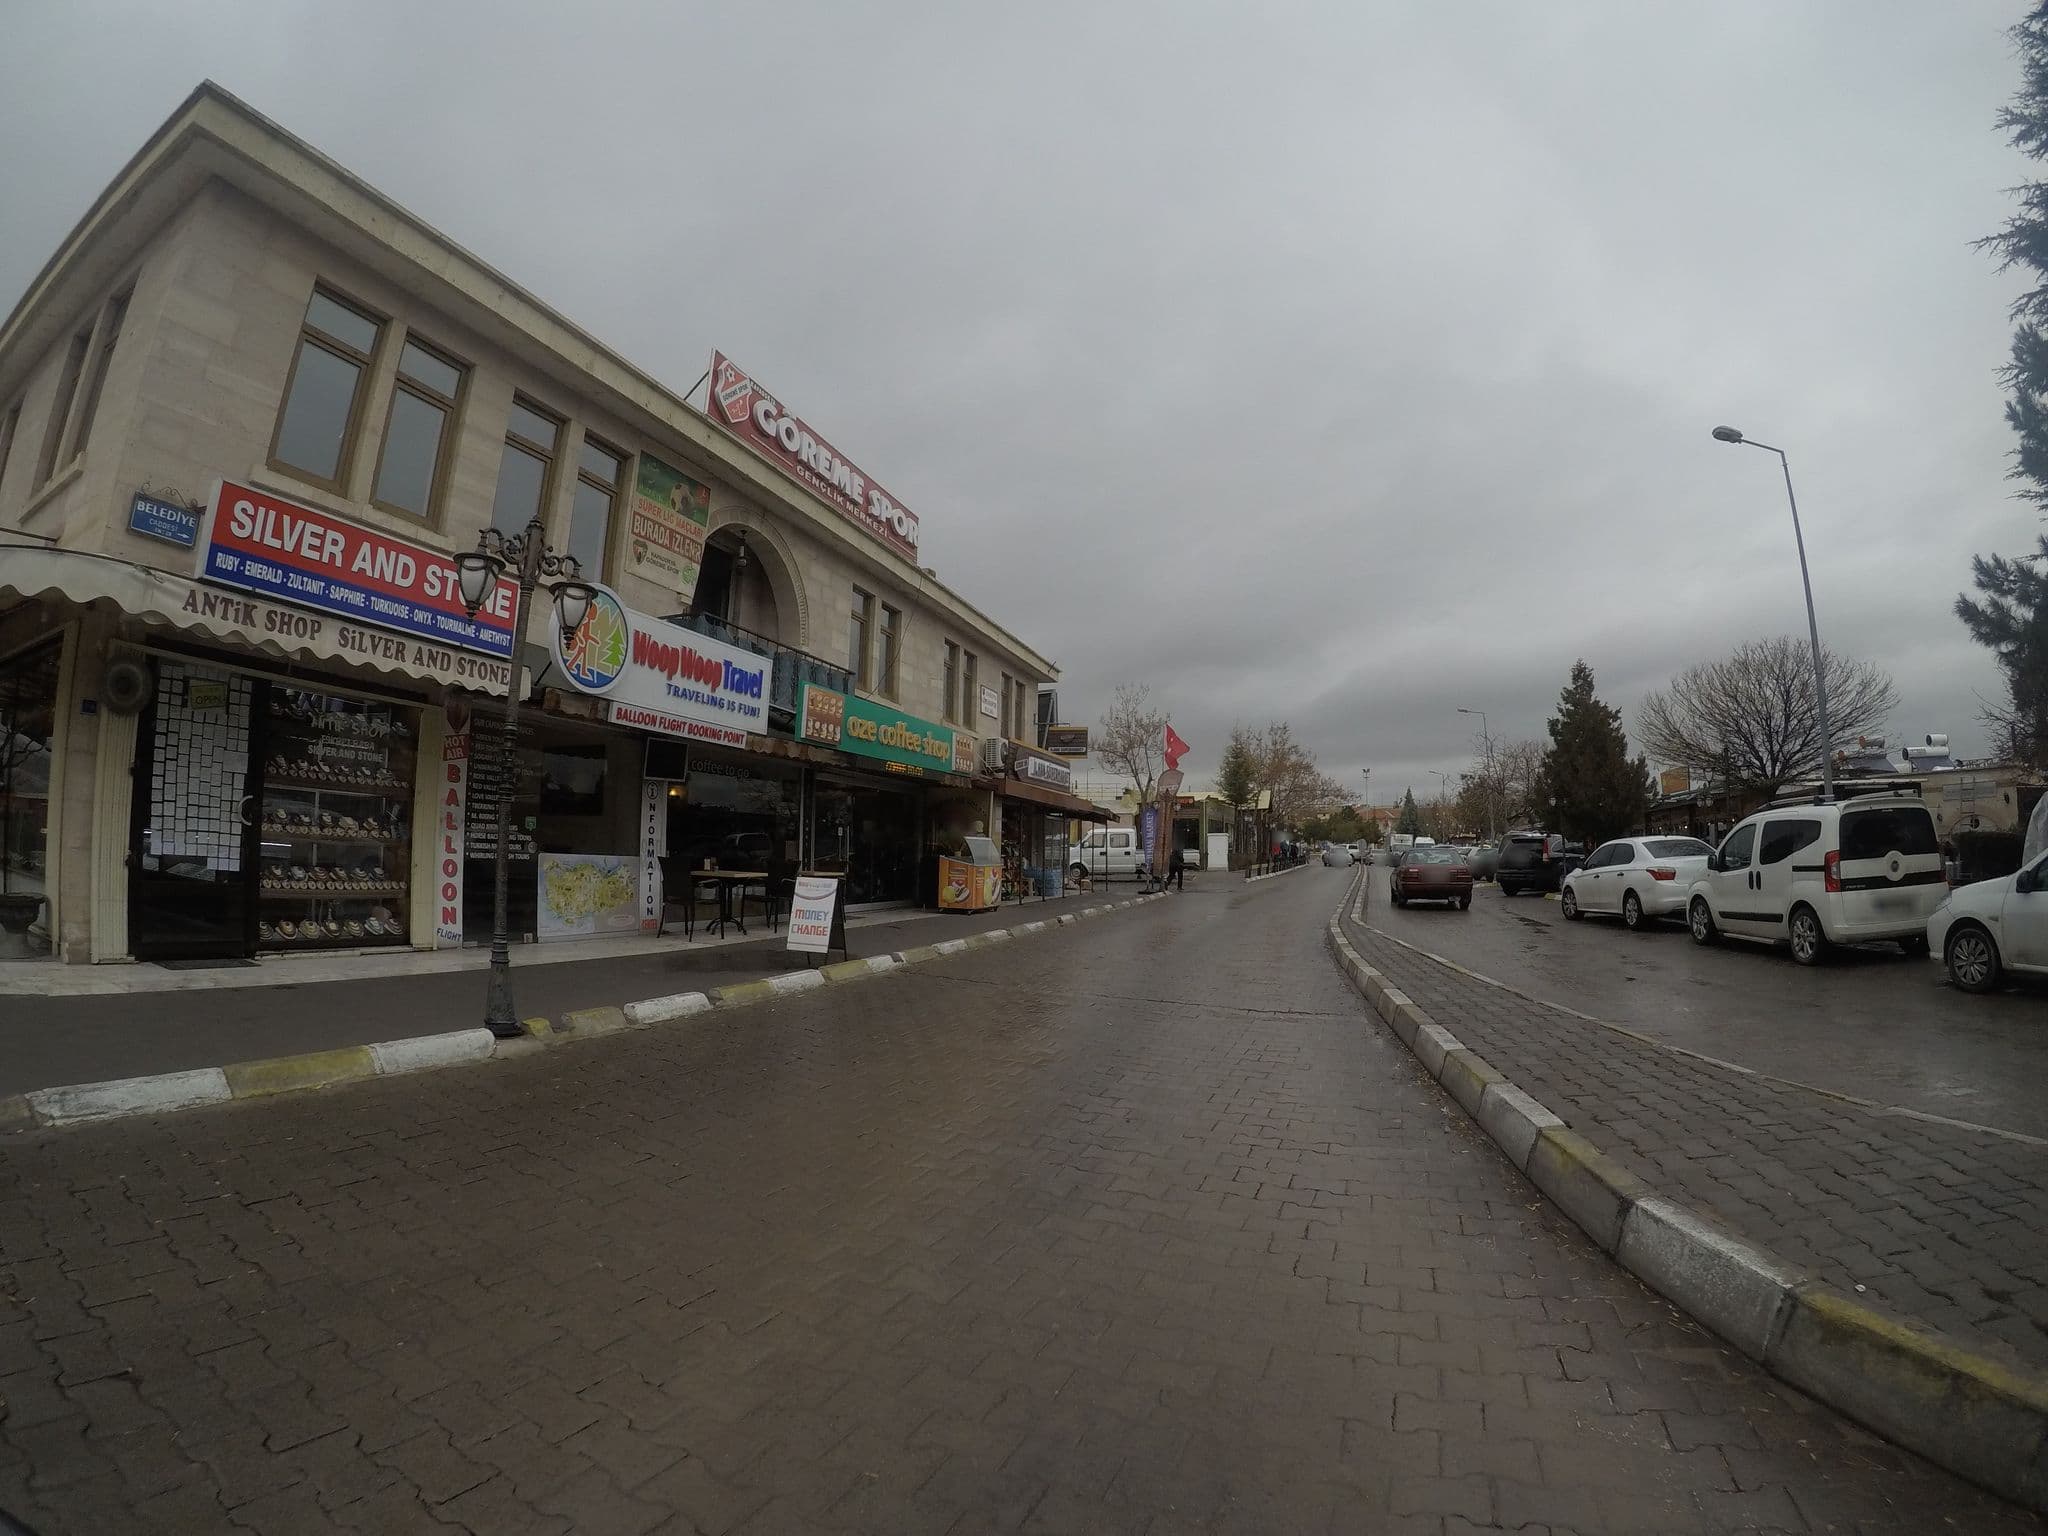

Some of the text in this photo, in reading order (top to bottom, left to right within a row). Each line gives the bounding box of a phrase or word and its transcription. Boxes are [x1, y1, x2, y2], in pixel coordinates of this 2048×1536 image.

[633, 515, 670, 549] BURADA
[868, 489, 919, 548] SPOR
[230, 500, 346, 568] SILVER
[351, 541, 417, 588] AND
[215, 552, 241, 572] RUBY
[244, 560, 282, 584] EMERALD
[287, 573, 326, 596] ZULTANIT
[329, 584, 367, 608] SAPPHIRE
[413, 608, 433, 626] ONYX
[480, 627, 511, 648] AMETHYST
[264, 609, 322, 641] SHOP
[412, 646, 452, 673] AND
[456, 657, 511, 686] STONE
[666, 682, 761, 719] TRAVELING IS FUN!
[445, 736, 465, 748] HOT
[615, 707, 746, 745] BALLOON FLIGHT BOOKING POINT
[847, 715, 950, 763] oze coffee shop
[446, 747, 464, 759] AIR
[691, 758, 750, 781] coffee to go
[442, 763, 461, 925] BALLOON
[791, 923, 828, 937] CHANGE
[795, 908, 829, 921] MONEY
[436, 927, 462, 942] FLIGHT
